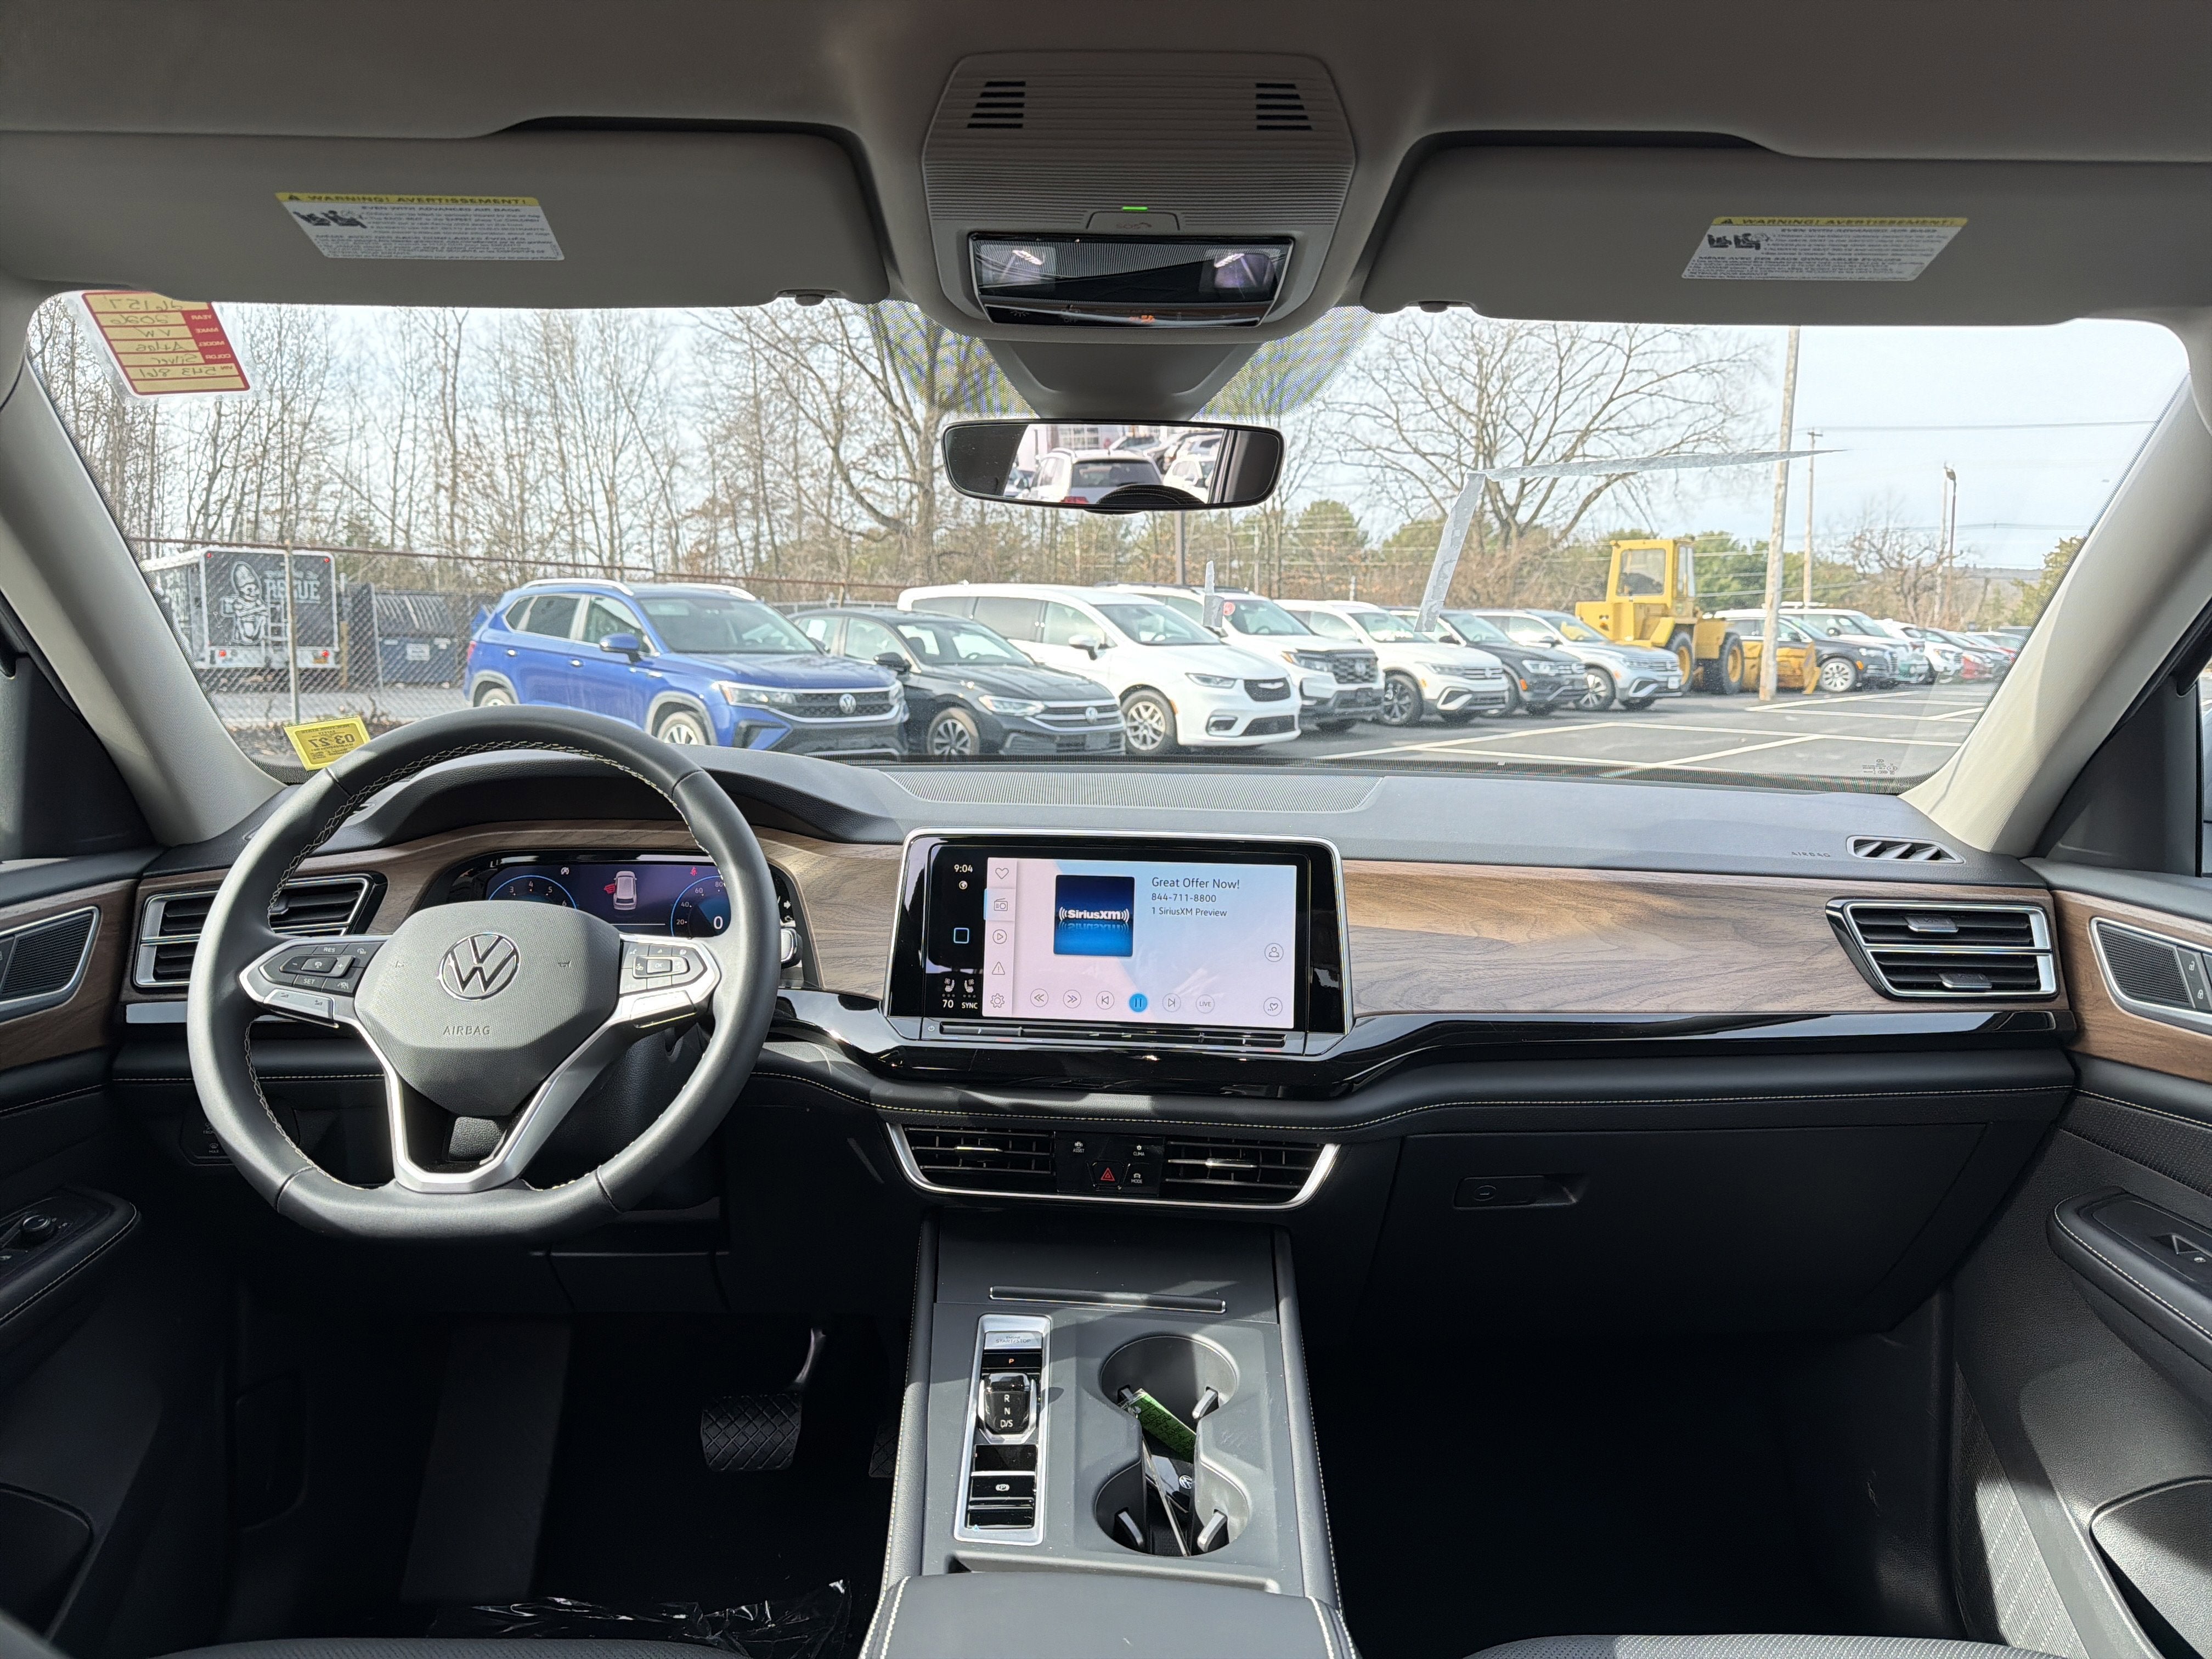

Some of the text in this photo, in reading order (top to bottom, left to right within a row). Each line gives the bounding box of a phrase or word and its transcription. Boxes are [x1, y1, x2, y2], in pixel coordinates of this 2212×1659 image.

[954, 864, 973, 872] 9:04
[1152, 877, 1240, 889] Great Offer Now!
[1151, 893, 1217, 902] 844-711-8800
[1151, 906, 1227, 917] 1 SiriusXM Preview
[713, 916, 724, 929] 0
[943, 999, 954, 1008] 70
[443, 1025, 490, 1035] AIRBAG
[1004, 1394, 1010, 1403] R
[1000, 1419, 1013, 1427] D/S
